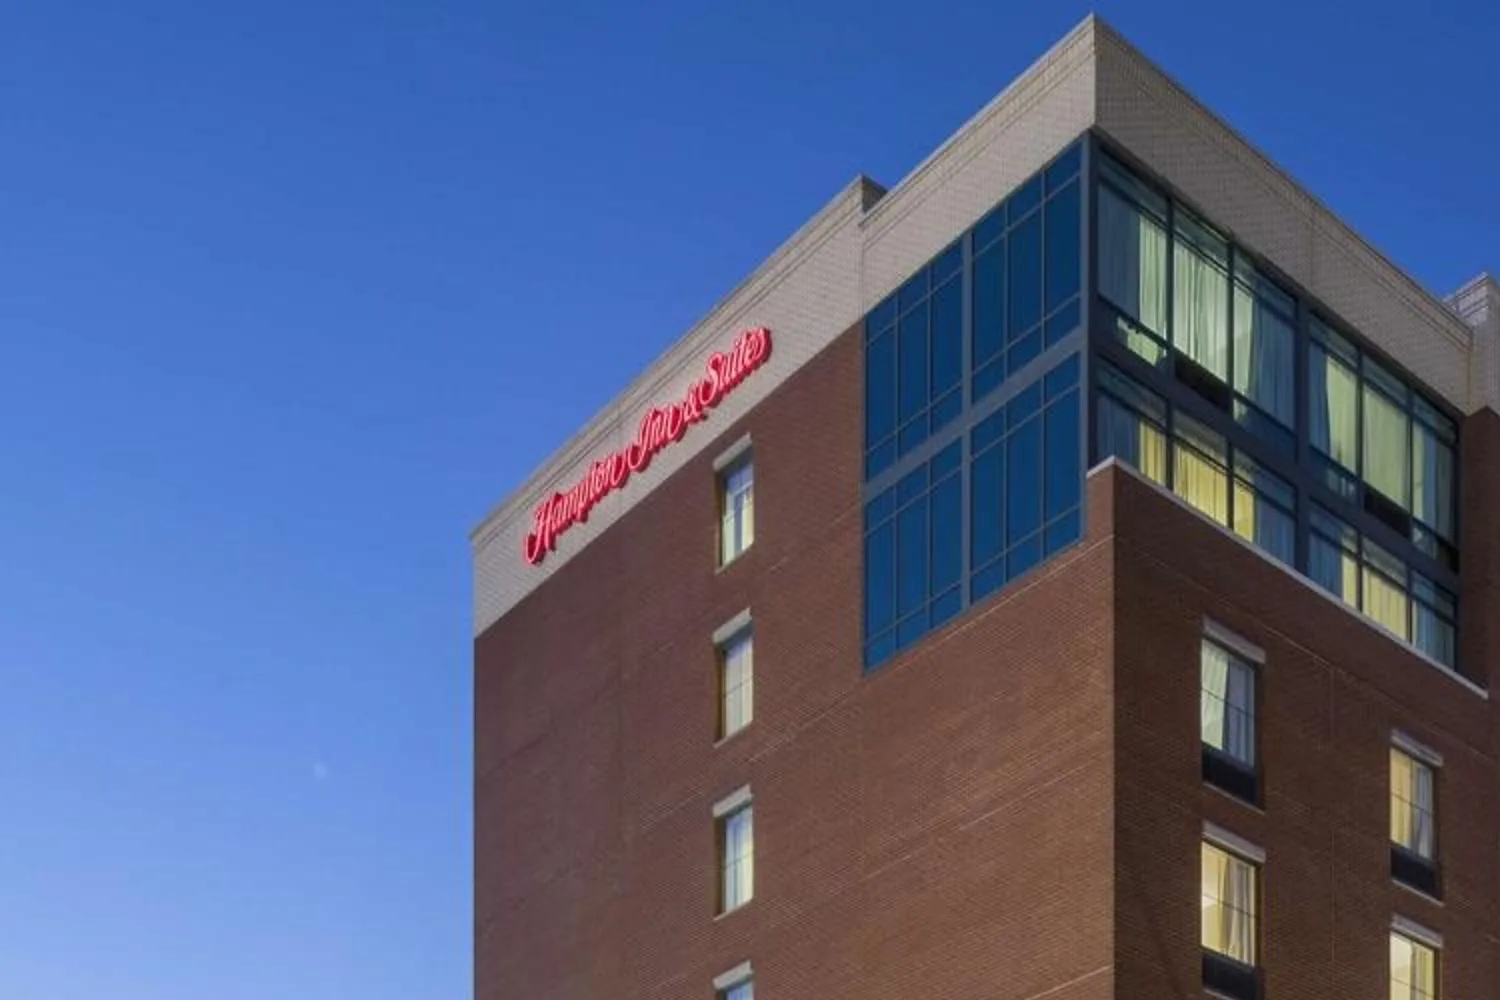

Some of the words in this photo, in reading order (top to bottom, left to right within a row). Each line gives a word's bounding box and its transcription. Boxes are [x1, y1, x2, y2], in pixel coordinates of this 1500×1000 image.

[523, 454, 629, 564] Hampton
[628, 404, 690, 473] Inn
[700, 326, 772, 409] Suites
